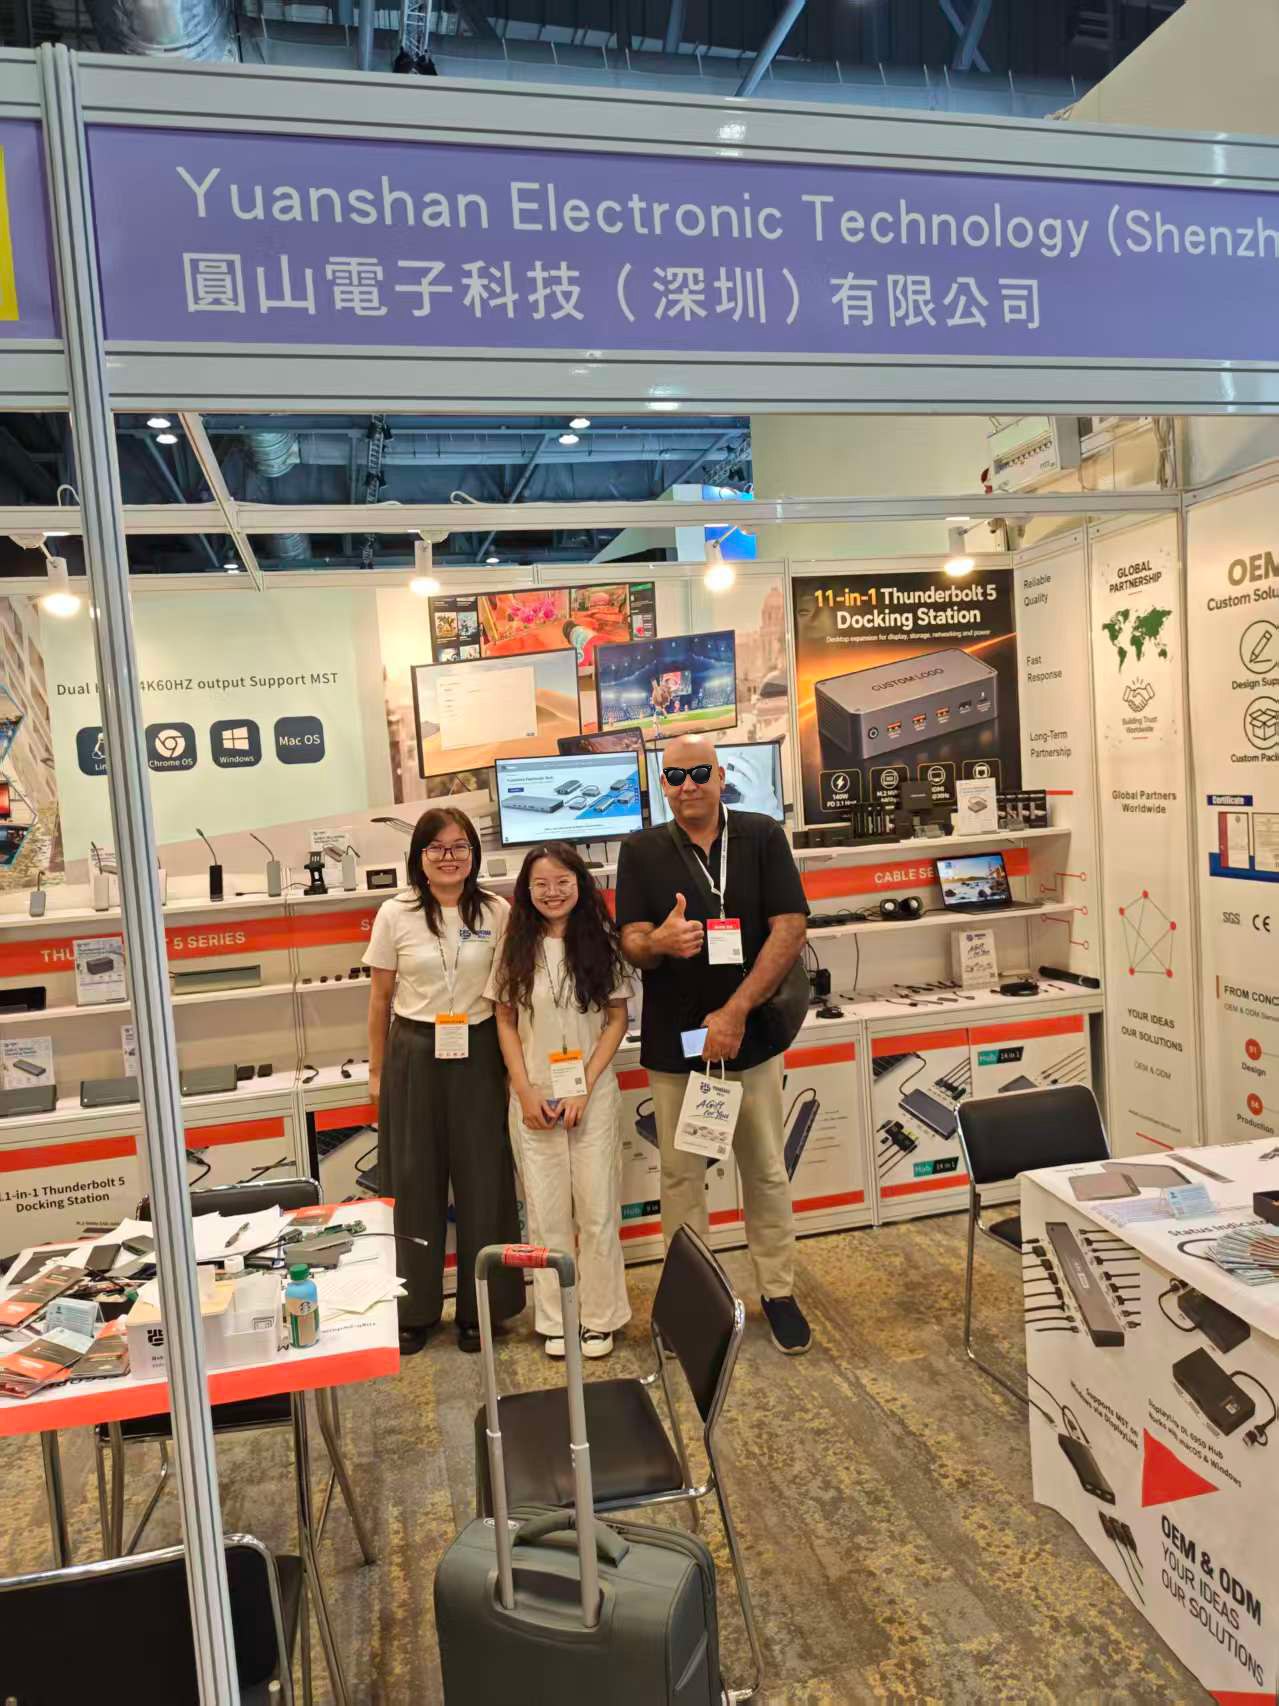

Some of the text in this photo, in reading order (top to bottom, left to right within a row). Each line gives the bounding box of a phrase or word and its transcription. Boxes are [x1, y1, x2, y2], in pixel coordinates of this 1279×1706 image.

[176, 166, 489, 230] Yuanshan
[510, 181, 783, 241] Electronic
[801, 194, 1090, 258] Technology
[1117, 560, 1152, 579] GLOBAL
[1024, 574, 1051, 589] Reliable
[1109, 571, 1162, 592] PARTNERSHIP
[814, 584, 997, 608] 11-in-1 Thunderbolt 5
[1024, 593, 1048, 607] Quality
[1207, 594, 1251, 611] Custom
[837, 606, 981, 630] Docking Station
[1026, 655, 1042, 666] Fast
[57, 683, 90, 696] Dual
[198, 677, 245, 691] output
[249, 674, 306, 689] Support
[310, 672, 338, 685] MST
[871, 668, 944, 692] CUSTOM LOGO
[1027, 669, 1062, 683] Response
[1231, 680, 1260, 690] Design
[279, 734, 320, 746] Mac OS
[1030, 729, 1068, 743] Long-Term
[220, 755, 254, 763] Windows
[1030, 746, 1071, 758] Partnership
[149, 758, 193, 768] Chrome OS
[1112, 790, 1176, 800] Global Partners
[1122, 803, 1166, 814] Worldwide
[874, 868, 917, 884] CABLE
[1222, 911, 1240, 925] SGS
[173, 937, 183, 949] 5
[187, 931, 246, 949] SERIES
[1223, 985, 1249, 1000] FROM
[1127, 1008, 1175, 1029] YOUR IDEAS
[1121, 1026, 1183, 1052] OUR SOLUTIONS
[1241, 1062, 1266, 1077] Design
[1236, 1113, 1275, 1135] Production
[42, 1177, 117, 1196] Thunderbolt
[118, 1176, 125, 1186] 5
[16, 1192, 110, 1213] Docking Station
[1168, 1225, 1214, 1238] Status
[1208, 1444, 1224, 1460] Hub
[1210, 1458, 1242, 1488] Windows
[1161, 1514, 1262, 1627] OEM & ODM
[1162, 1540, 1240, 1631] YOUR IDEAS
[1162, 1568, 1264, 1688] OUR SOLUTIONS
